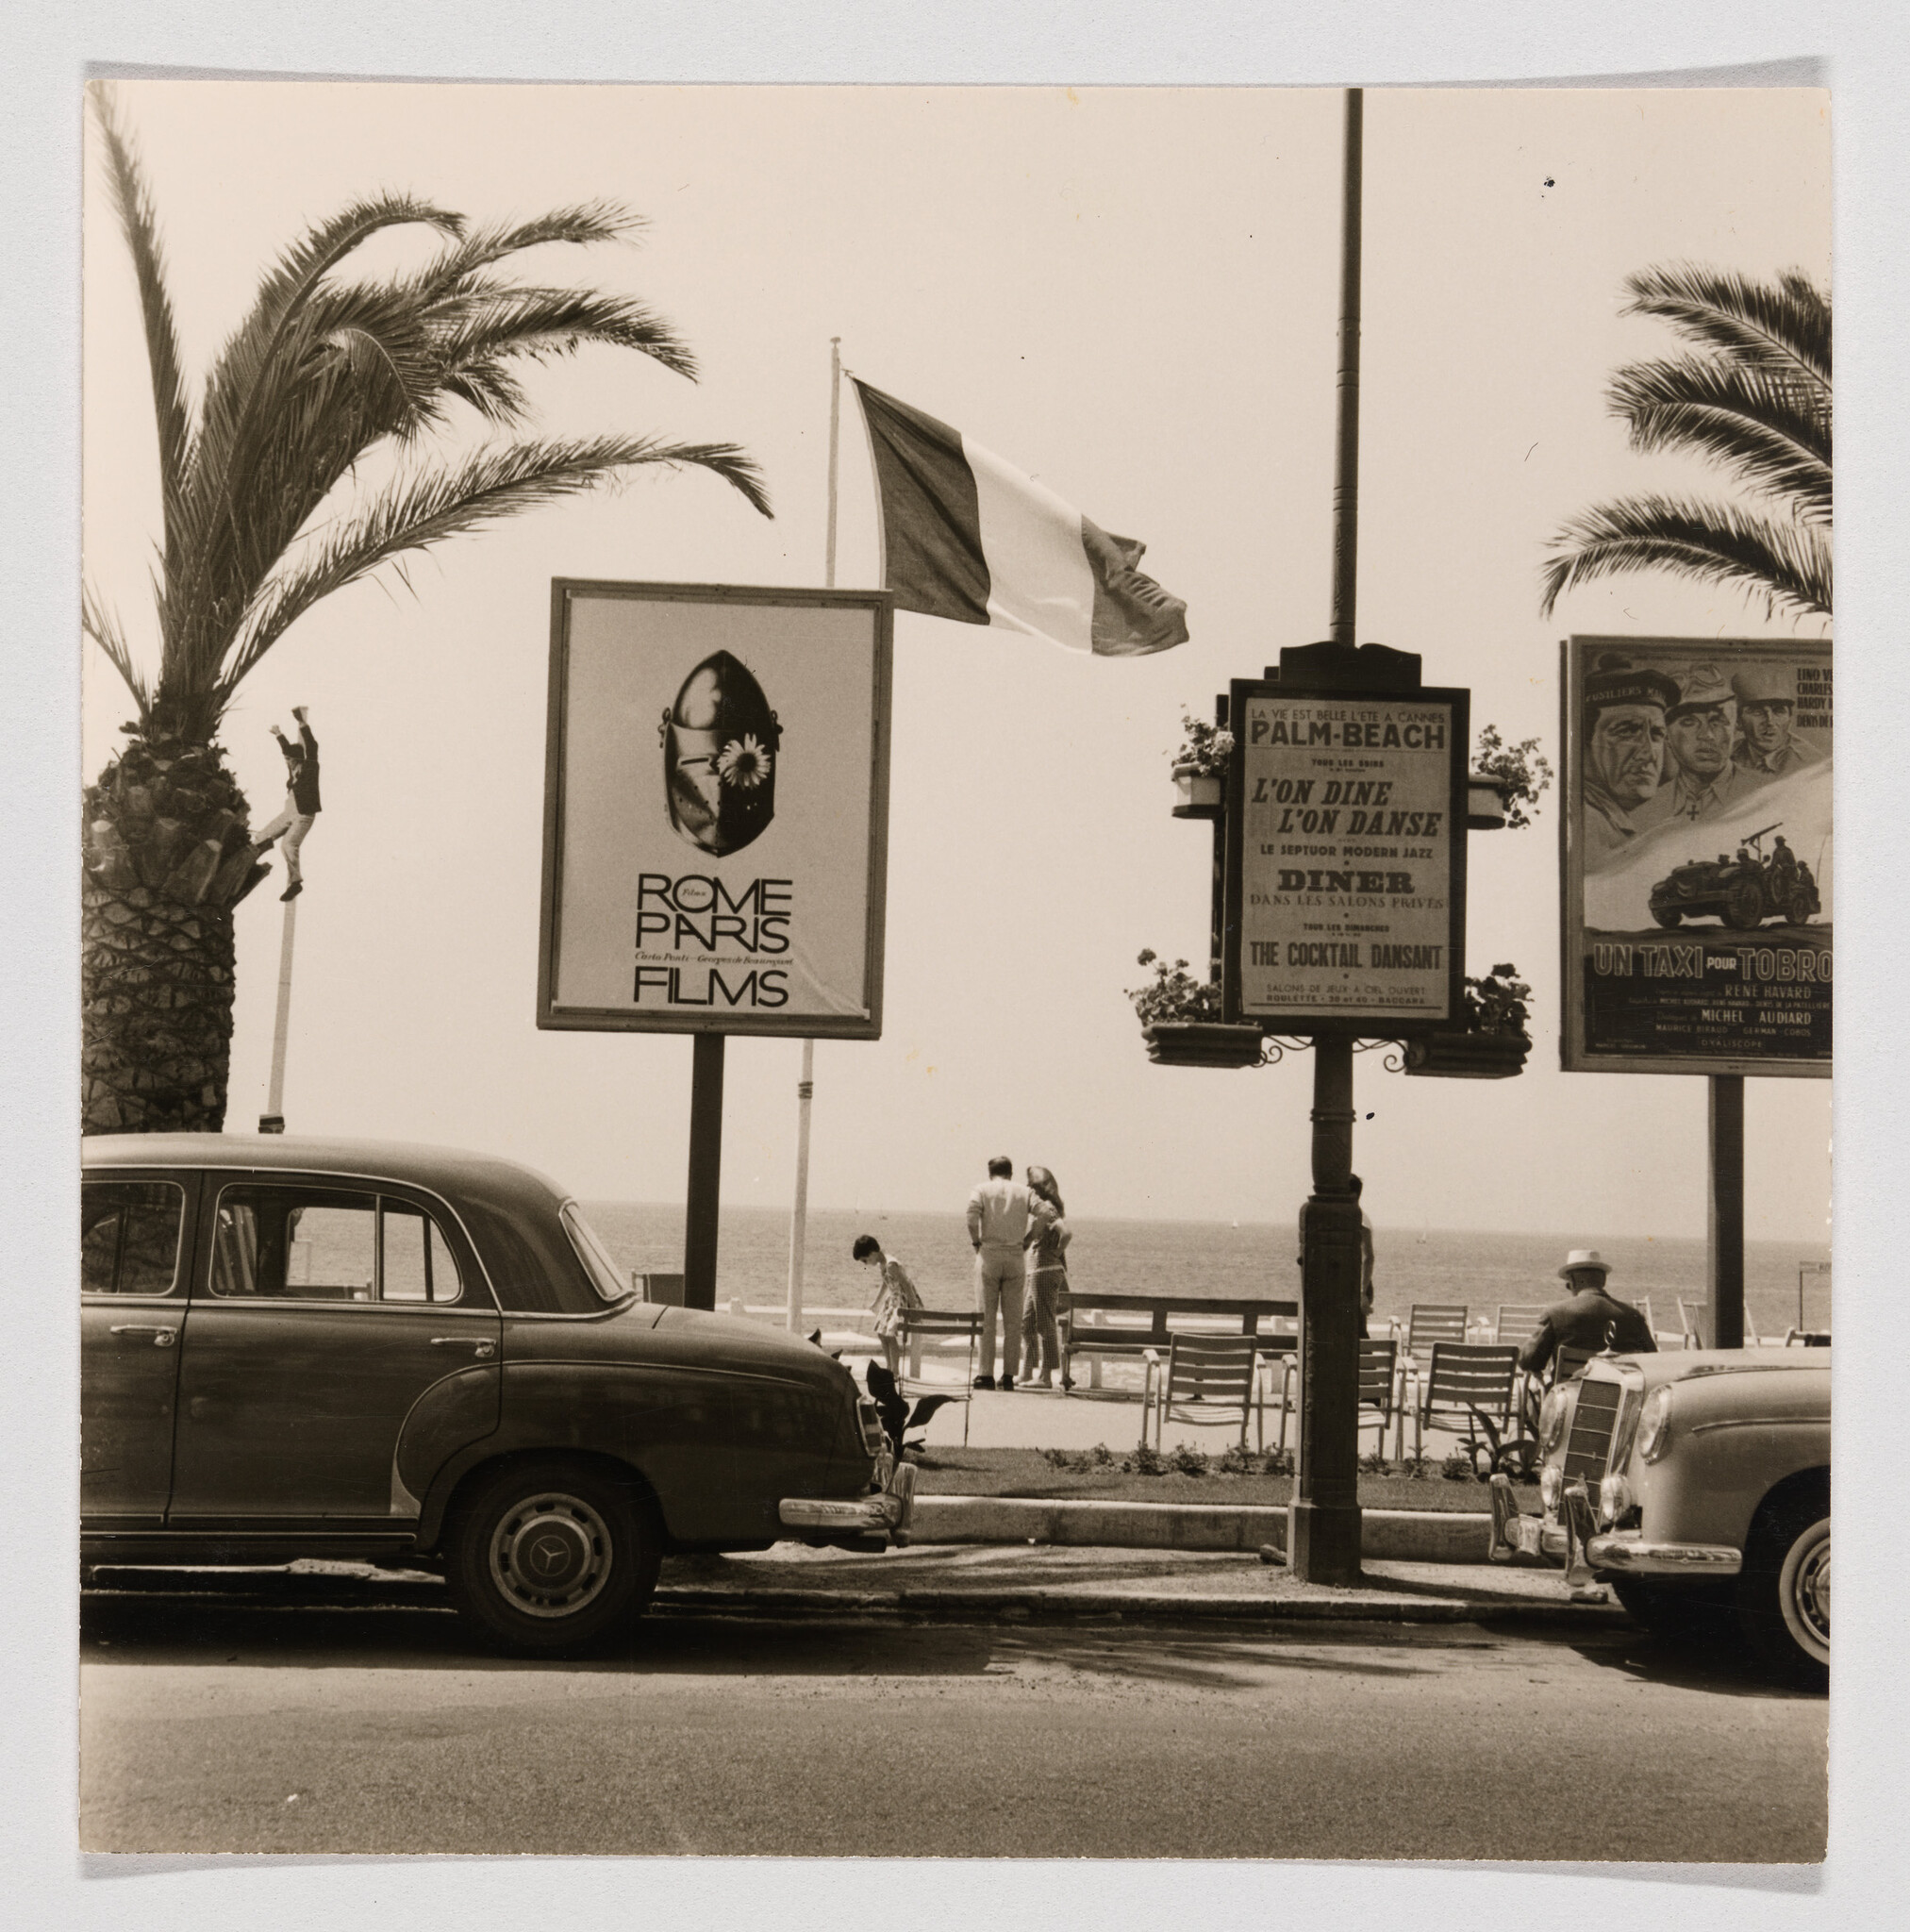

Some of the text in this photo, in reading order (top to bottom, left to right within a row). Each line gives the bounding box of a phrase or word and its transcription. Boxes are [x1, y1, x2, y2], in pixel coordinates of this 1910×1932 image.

[1797, 668, 1820, 681] LINO
[1797, 682, 1833, 695] CHARLES
[1797, 696, 1827, 709] HARDY
[1252, 708, 1266, 720] LA
[1271, 708, 1287, 720] VIE
[1292, 708, 1311, 721] EST
[1317, 709, 1347, 721] BELLE
[1398, 711, 1445, 724] CANNES
[1251, 720, 1445, 750] PALM-BEACH
[1252, 778, 1394, 807] L'ON DINE
[1277, 808, 1443, 837] L'ON DANSE
[1260, 844, 1434, 859] LE SEPTUOR MODERN JAZZ
[1277, 869, 1416, 894] DINER
[637, 873, 793, 917] ROME
[1250, 893, 1291, 907] DANS
[1297, 894, 1322, 907] LES
[1328, 895, 1387, 908] SALONS
[636, 911, 791, 954] PARIS
[1250, 941, 1443, 971] THE COCKTAIL DANSANT
[1593, 943, 1833, 983] UN TAXI POUR TOBRO
[634, 965, 789, 1008] FILMS
[1267, 984, 1305, 993] SALONS
[1309, 984, 1320, 993] DE
[1326, 985, 1348, 993] JEUX
[1364, 986, 1383, 994] CIEL
[1388, 986, 1425, 995] OUVERT
[1764, 985, 1812, 1000] HAVARD
[1266, 994, 1318, 1003] ROULETTE
[1701, 1008, 1745, 1024] MICHEL
[1759, 1010, 1812, 1025] AUDIARD
[1655, 1024, 1692, 1033] MAURICE
[1743, 1026, 1776, 1036] GERMAN
